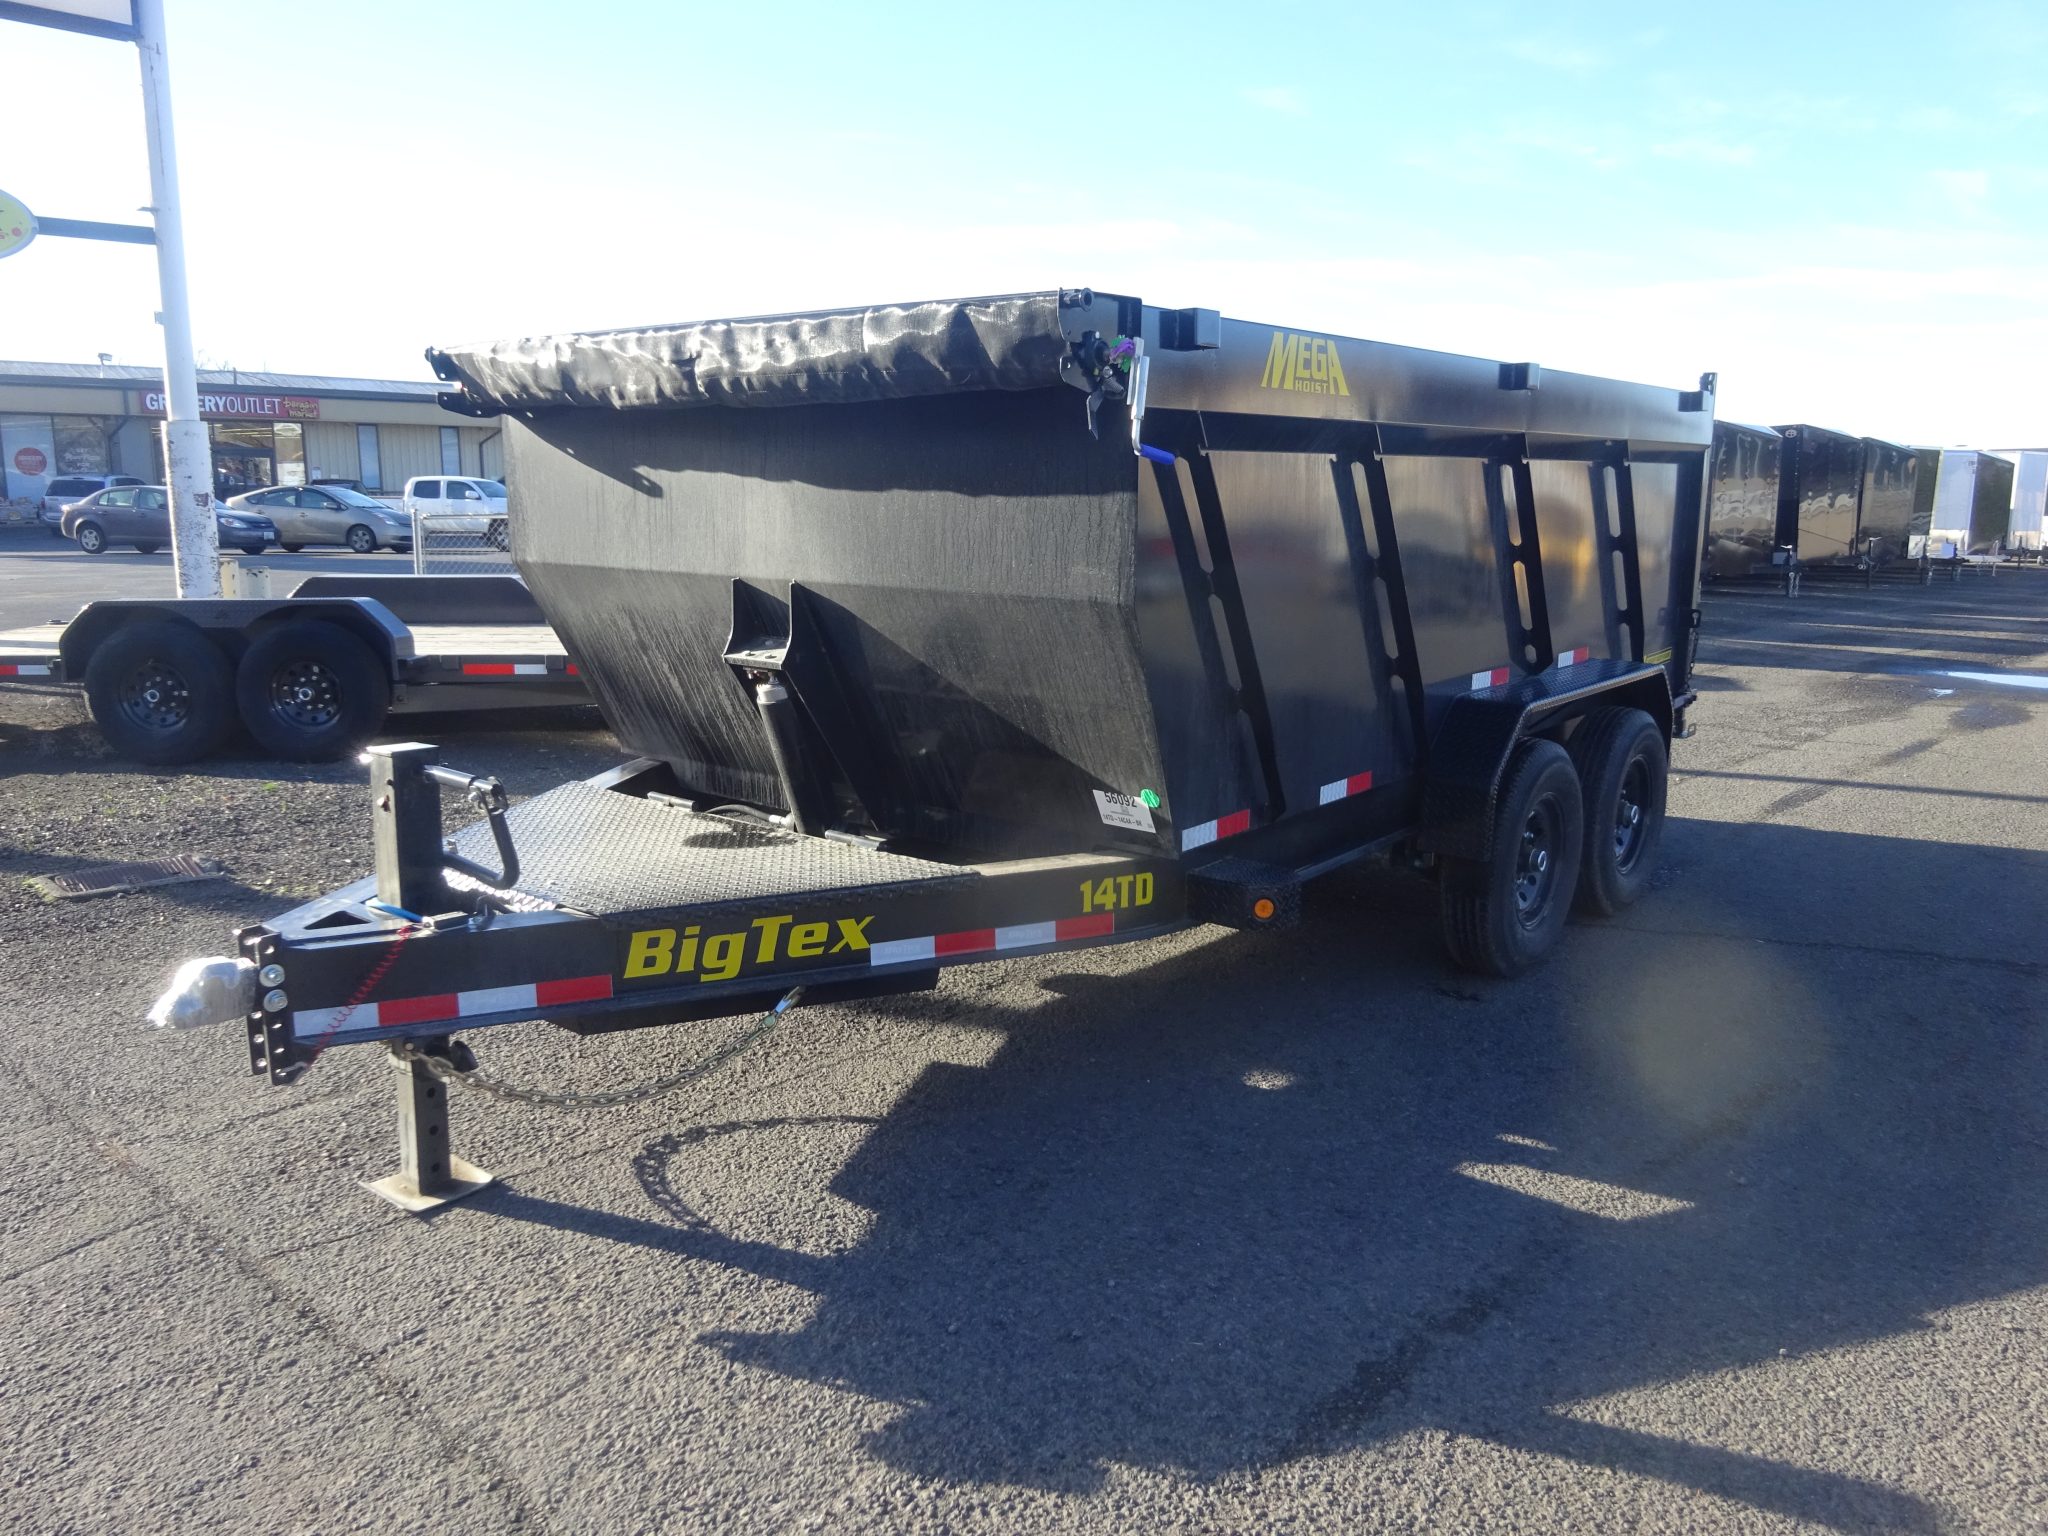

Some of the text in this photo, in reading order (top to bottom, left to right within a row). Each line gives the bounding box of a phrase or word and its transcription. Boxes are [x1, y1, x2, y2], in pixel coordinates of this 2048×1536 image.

[1261, 331, 1350, 396] MEGA
[1295, 379, 1329, 394] HOIST
[1104, 791, 1138, 808] 56092
[1080, 872, 1154, 913] 14TD
